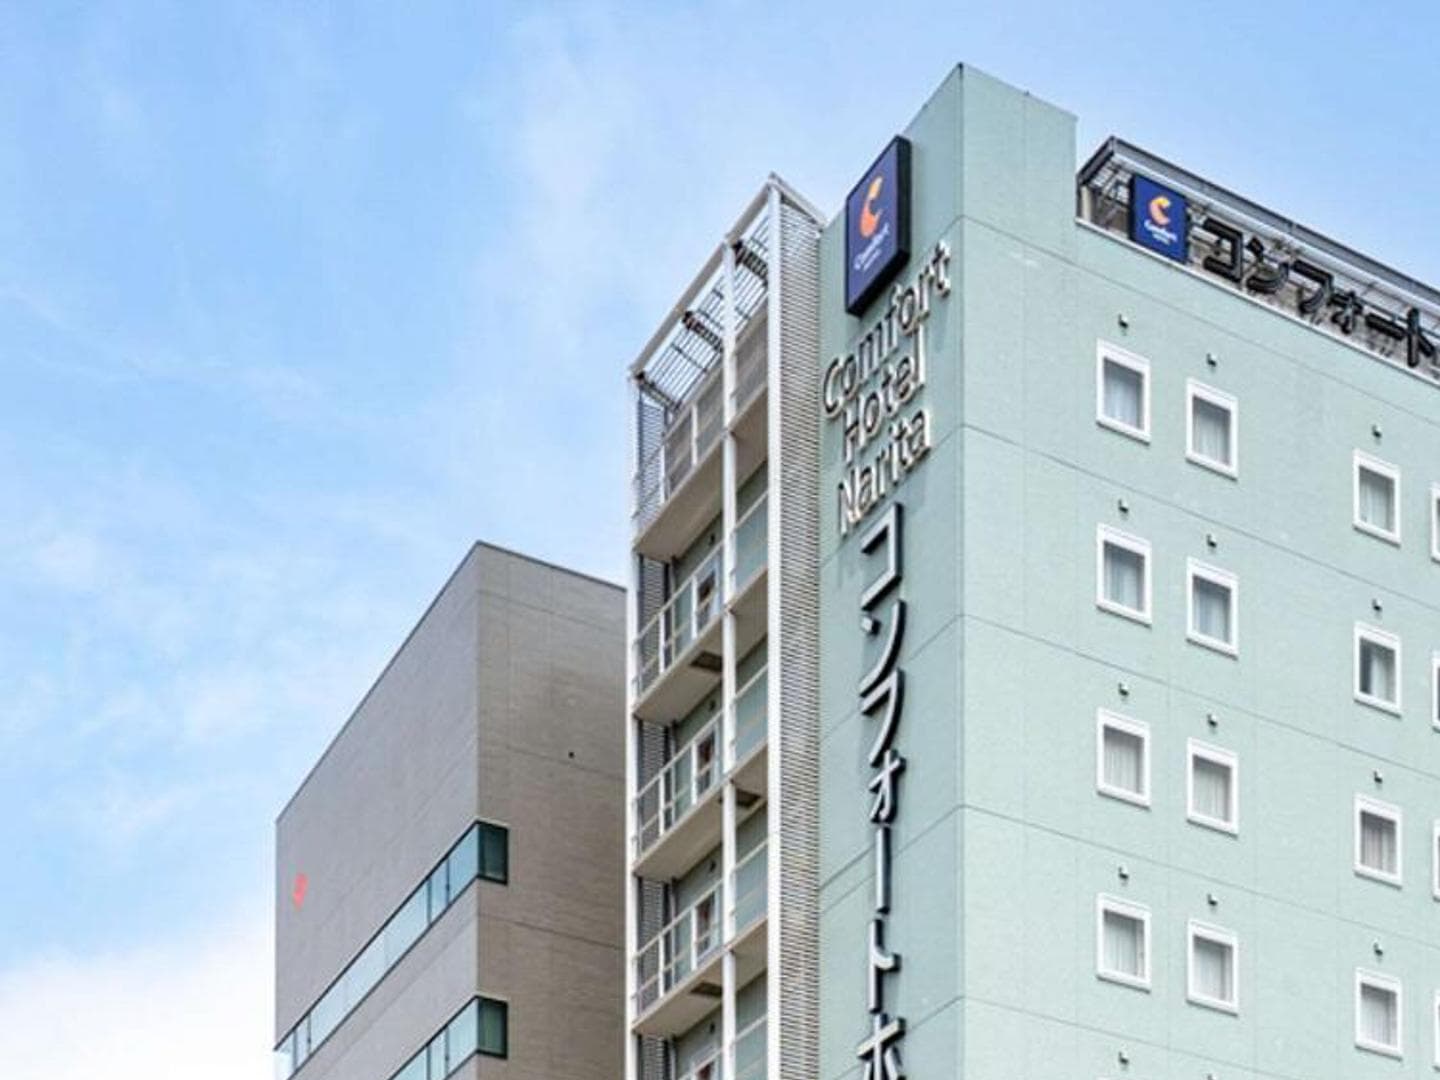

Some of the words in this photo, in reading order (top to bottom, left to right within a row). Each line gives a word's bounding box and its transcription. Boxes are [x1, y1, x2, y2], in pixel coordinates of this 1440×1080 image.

[823, 239, 951, 420] Comfort
[843, 326, 926, 464] Hotel
[837, 408, 932, 537] Narita
